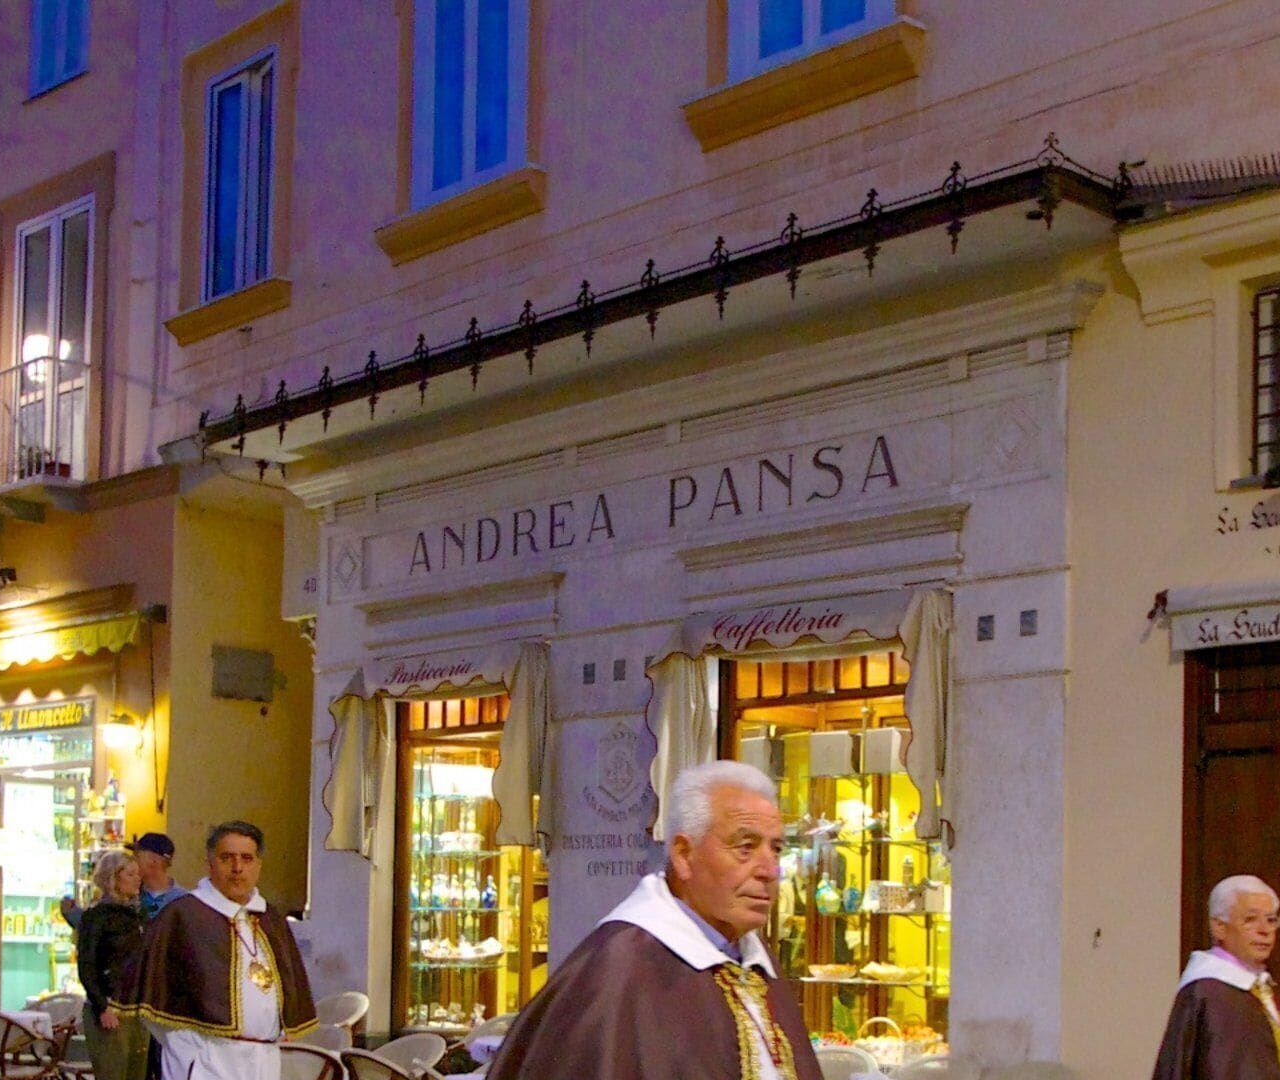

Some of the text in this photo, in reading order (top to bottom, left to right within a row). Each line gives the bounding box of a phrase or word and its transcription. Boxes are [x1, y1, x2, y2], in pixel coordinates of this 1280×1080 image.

[408, 434, 900, 578] ANDREA PANSA
[1217, 507, 1239, 535] La
[712, 606, 844, 651] Caffetteria
[1197, 618, 1220, 644] La
[384, 658, 474, 685] Pasticceria
